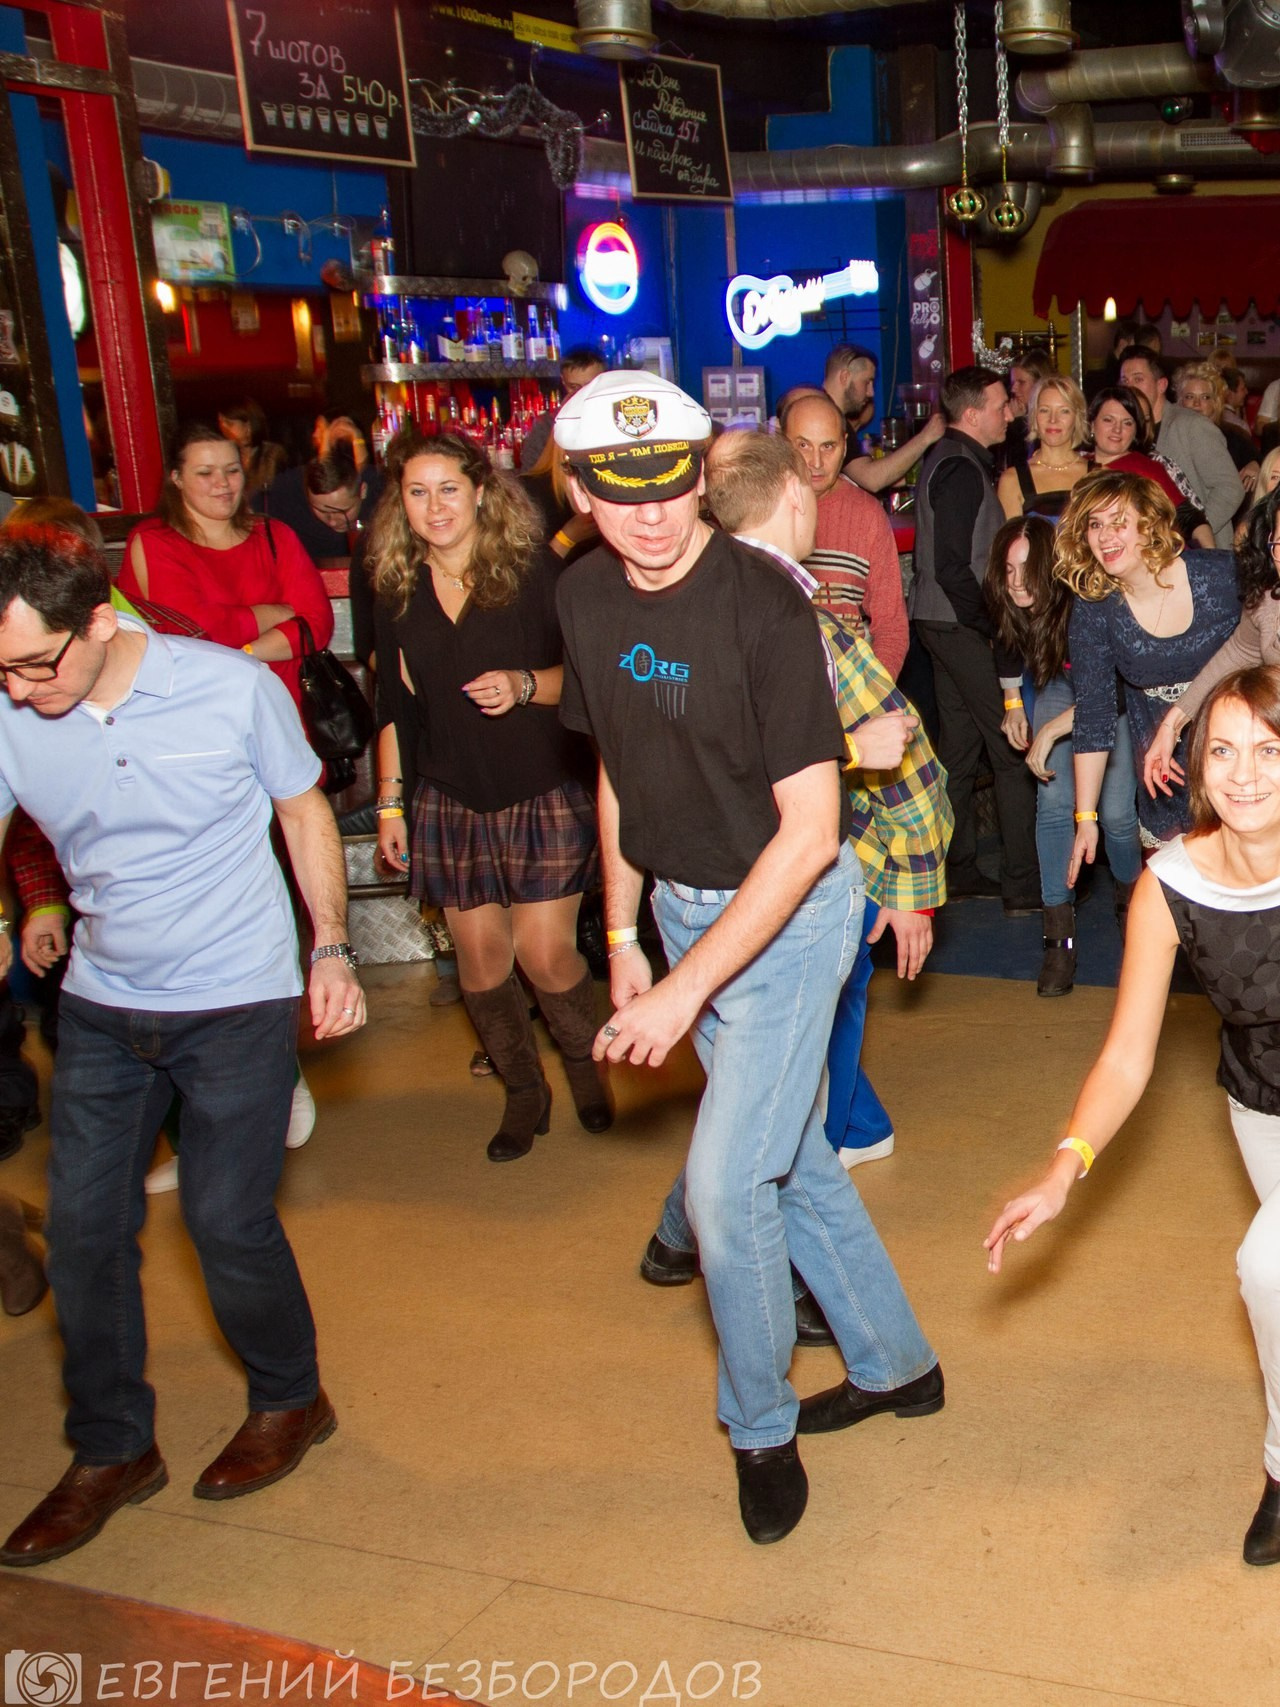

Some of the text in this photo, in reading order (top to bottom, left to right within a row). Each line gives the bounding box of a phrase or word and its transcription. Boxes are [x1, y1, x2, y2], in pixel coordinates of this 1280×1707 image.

[246, 9, 346, 73] 7 ШОТОВ
[299, 72, 331, 100] ЗА
[632, 110, 675, 136] Скидка
[608, 452, 615, 461] Я
[629, 446, 651, 457] ТАМ
[618, 643, 690, 682] ZORG
